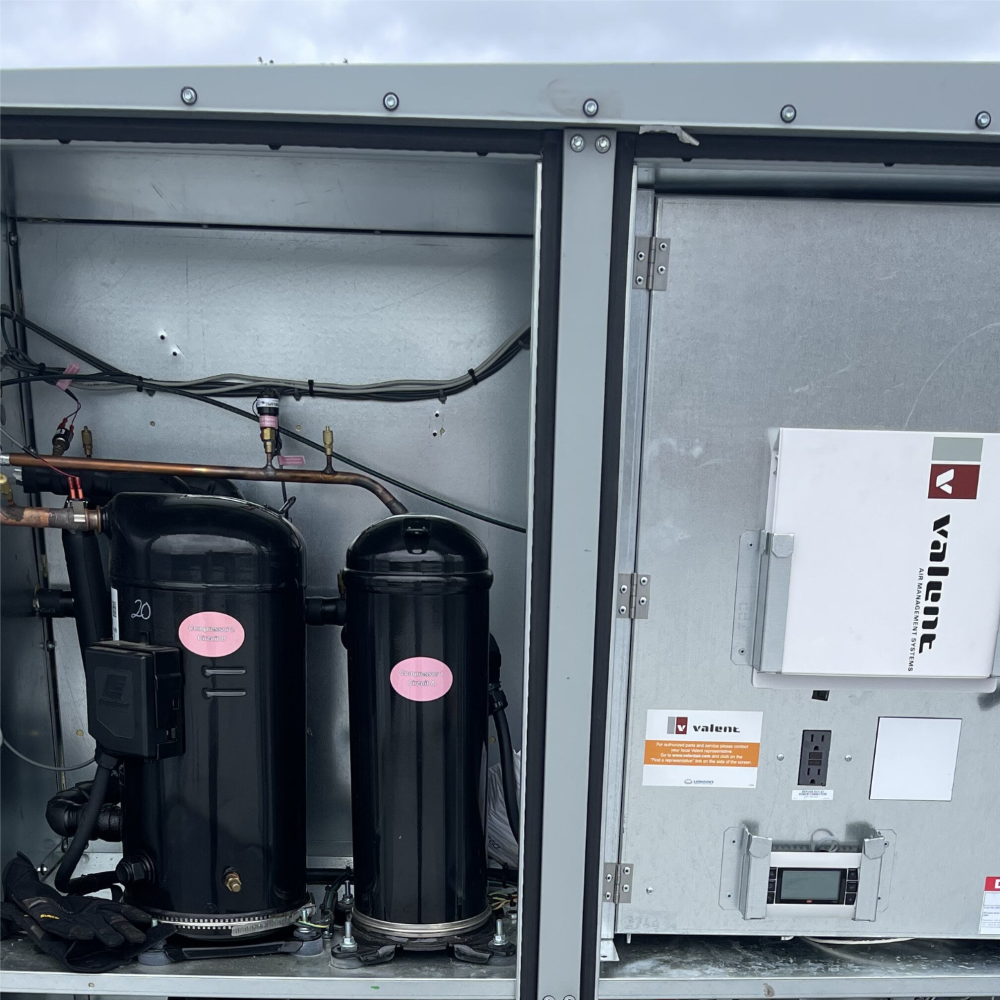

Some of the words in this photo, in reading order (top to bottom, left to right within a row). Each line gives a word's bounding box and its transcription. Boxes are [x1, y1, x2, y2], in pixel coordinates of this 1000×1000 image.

[918, 514, 951, 654] valent
[131, 599, 151, 620] 20
[911, 582, 923, 636] MANAGEMENT
[907, 637, 917, 672] SYSTEMS
[693, 724, 741, 733] valent
